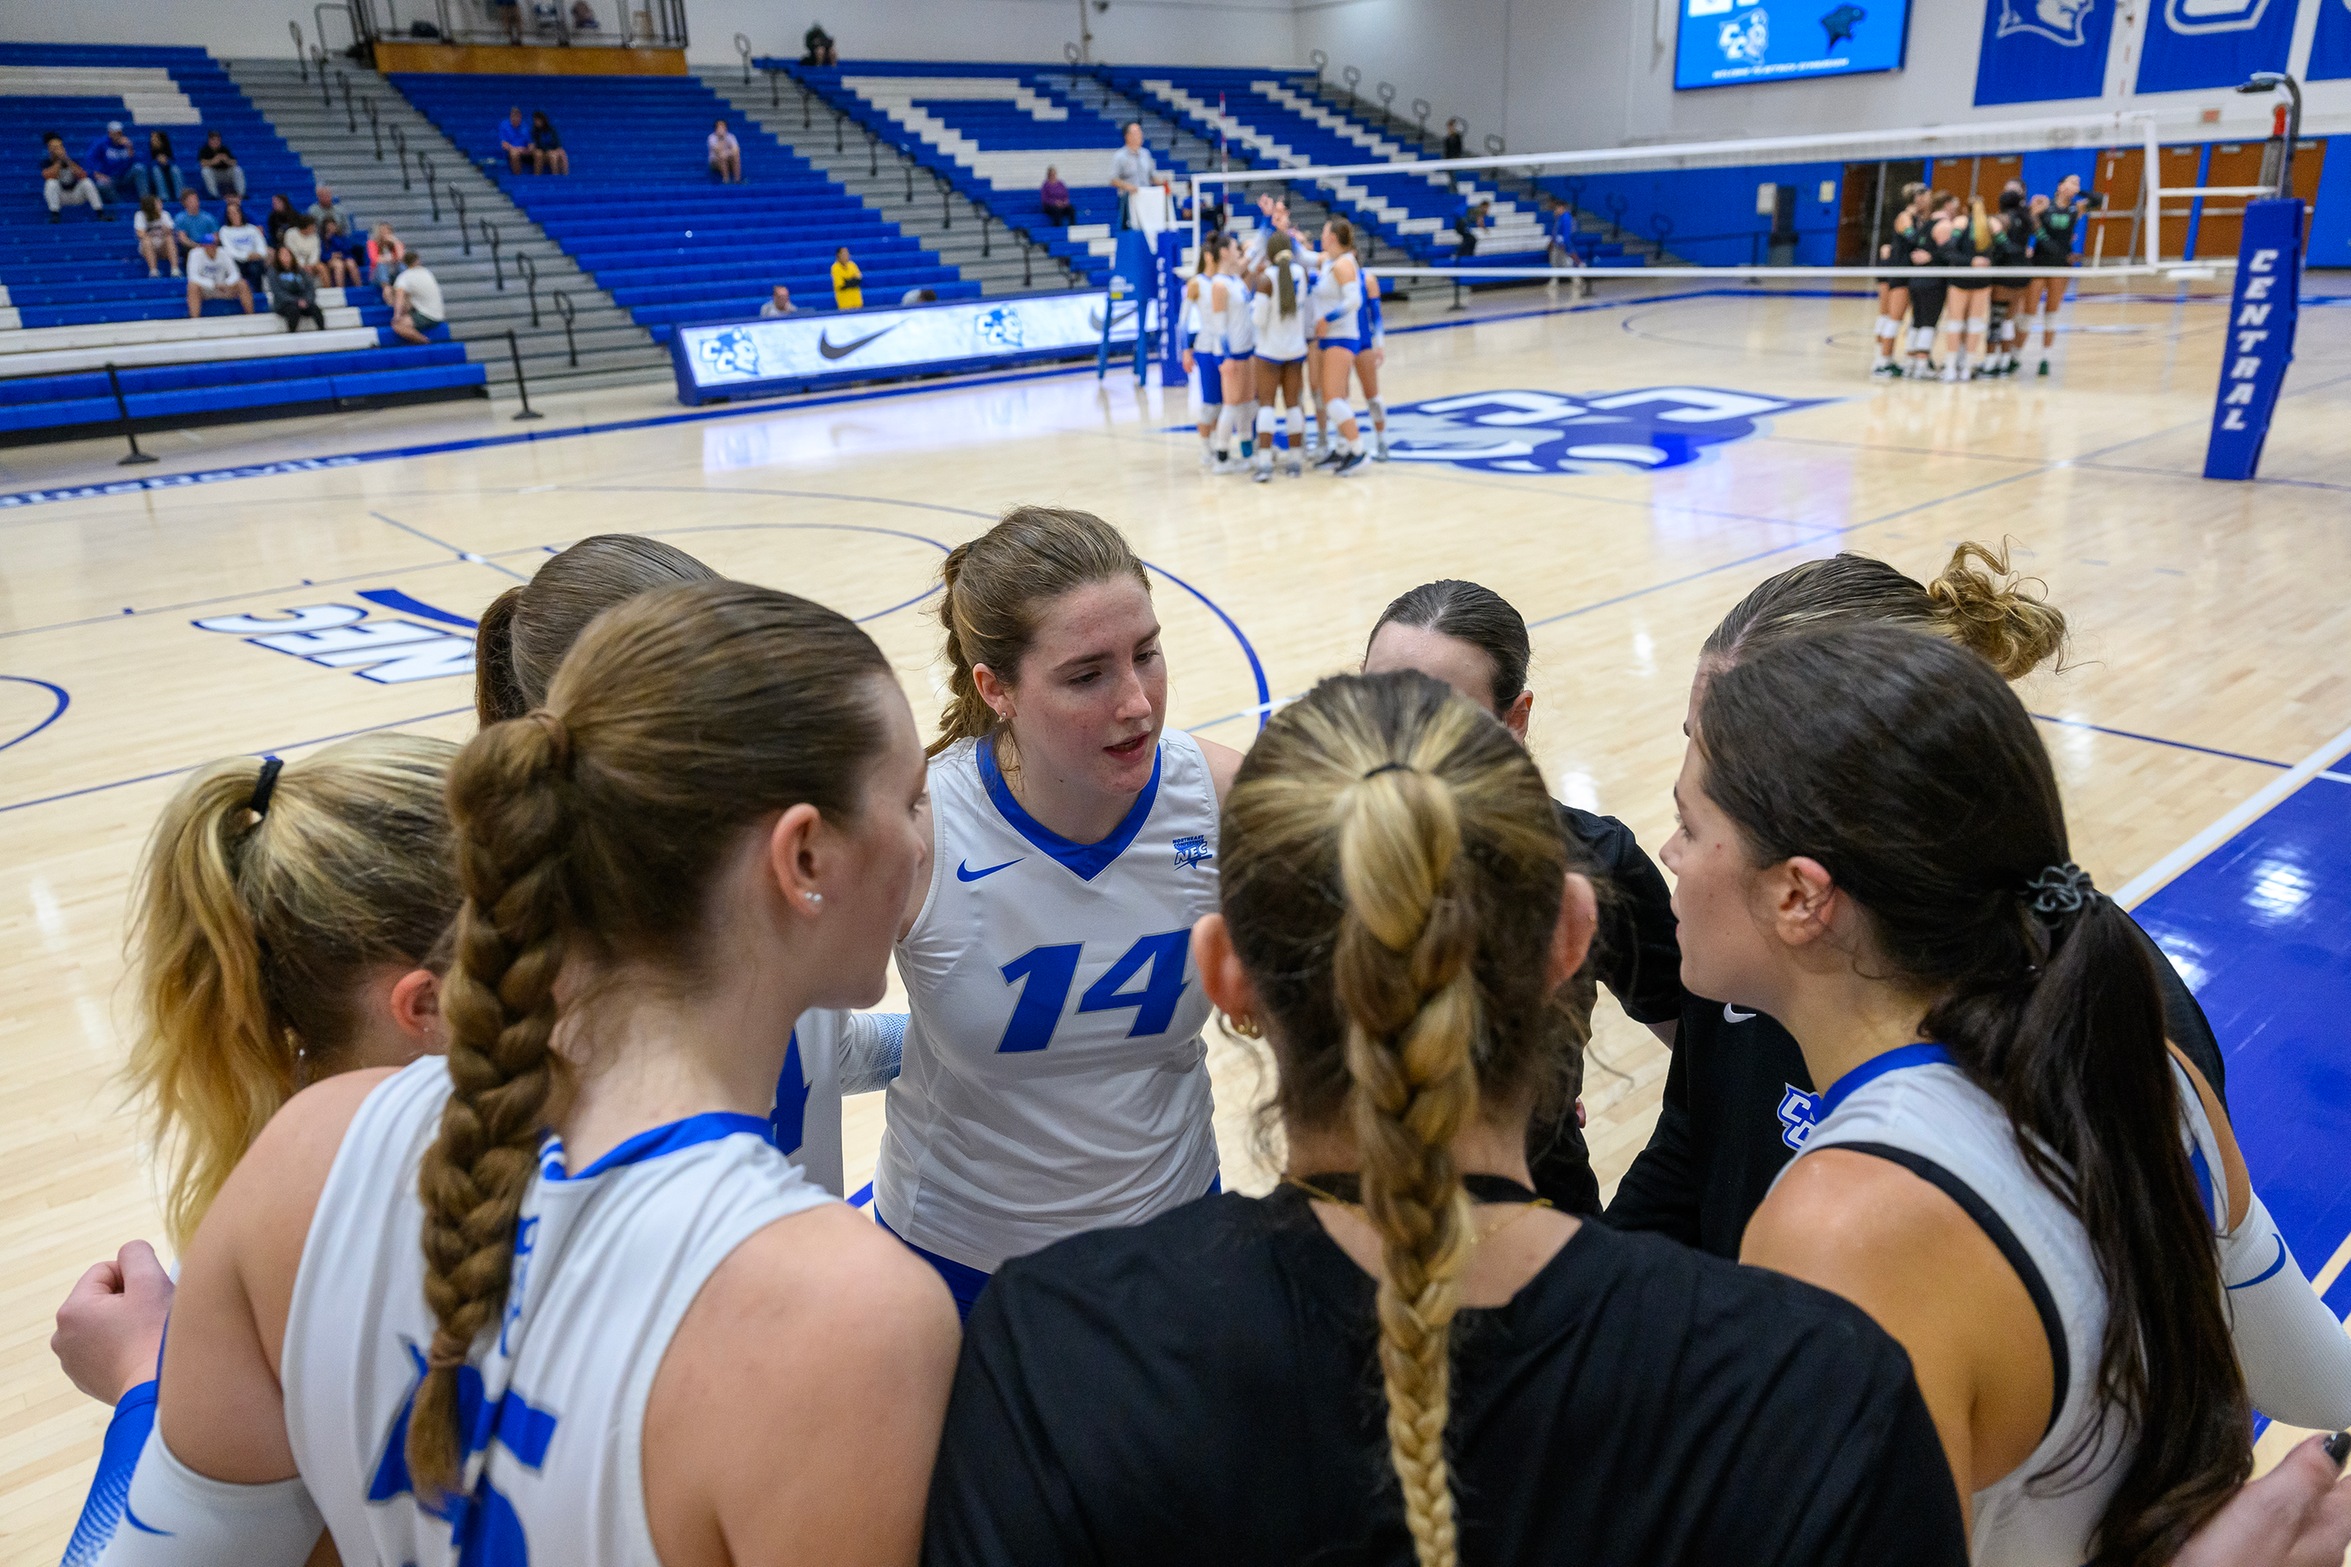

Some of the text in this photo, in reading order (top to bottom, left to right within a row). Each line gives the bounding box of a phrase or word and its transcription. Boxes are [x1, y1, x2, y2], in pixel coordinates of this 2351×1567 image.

[1155, 256, 1170, 361] CENTRAL
[2221, 248, 2280, 431] CENTRAL
[1174, 841, 1208, 866] NEC
[994, 921, 1192, 1054] 14
